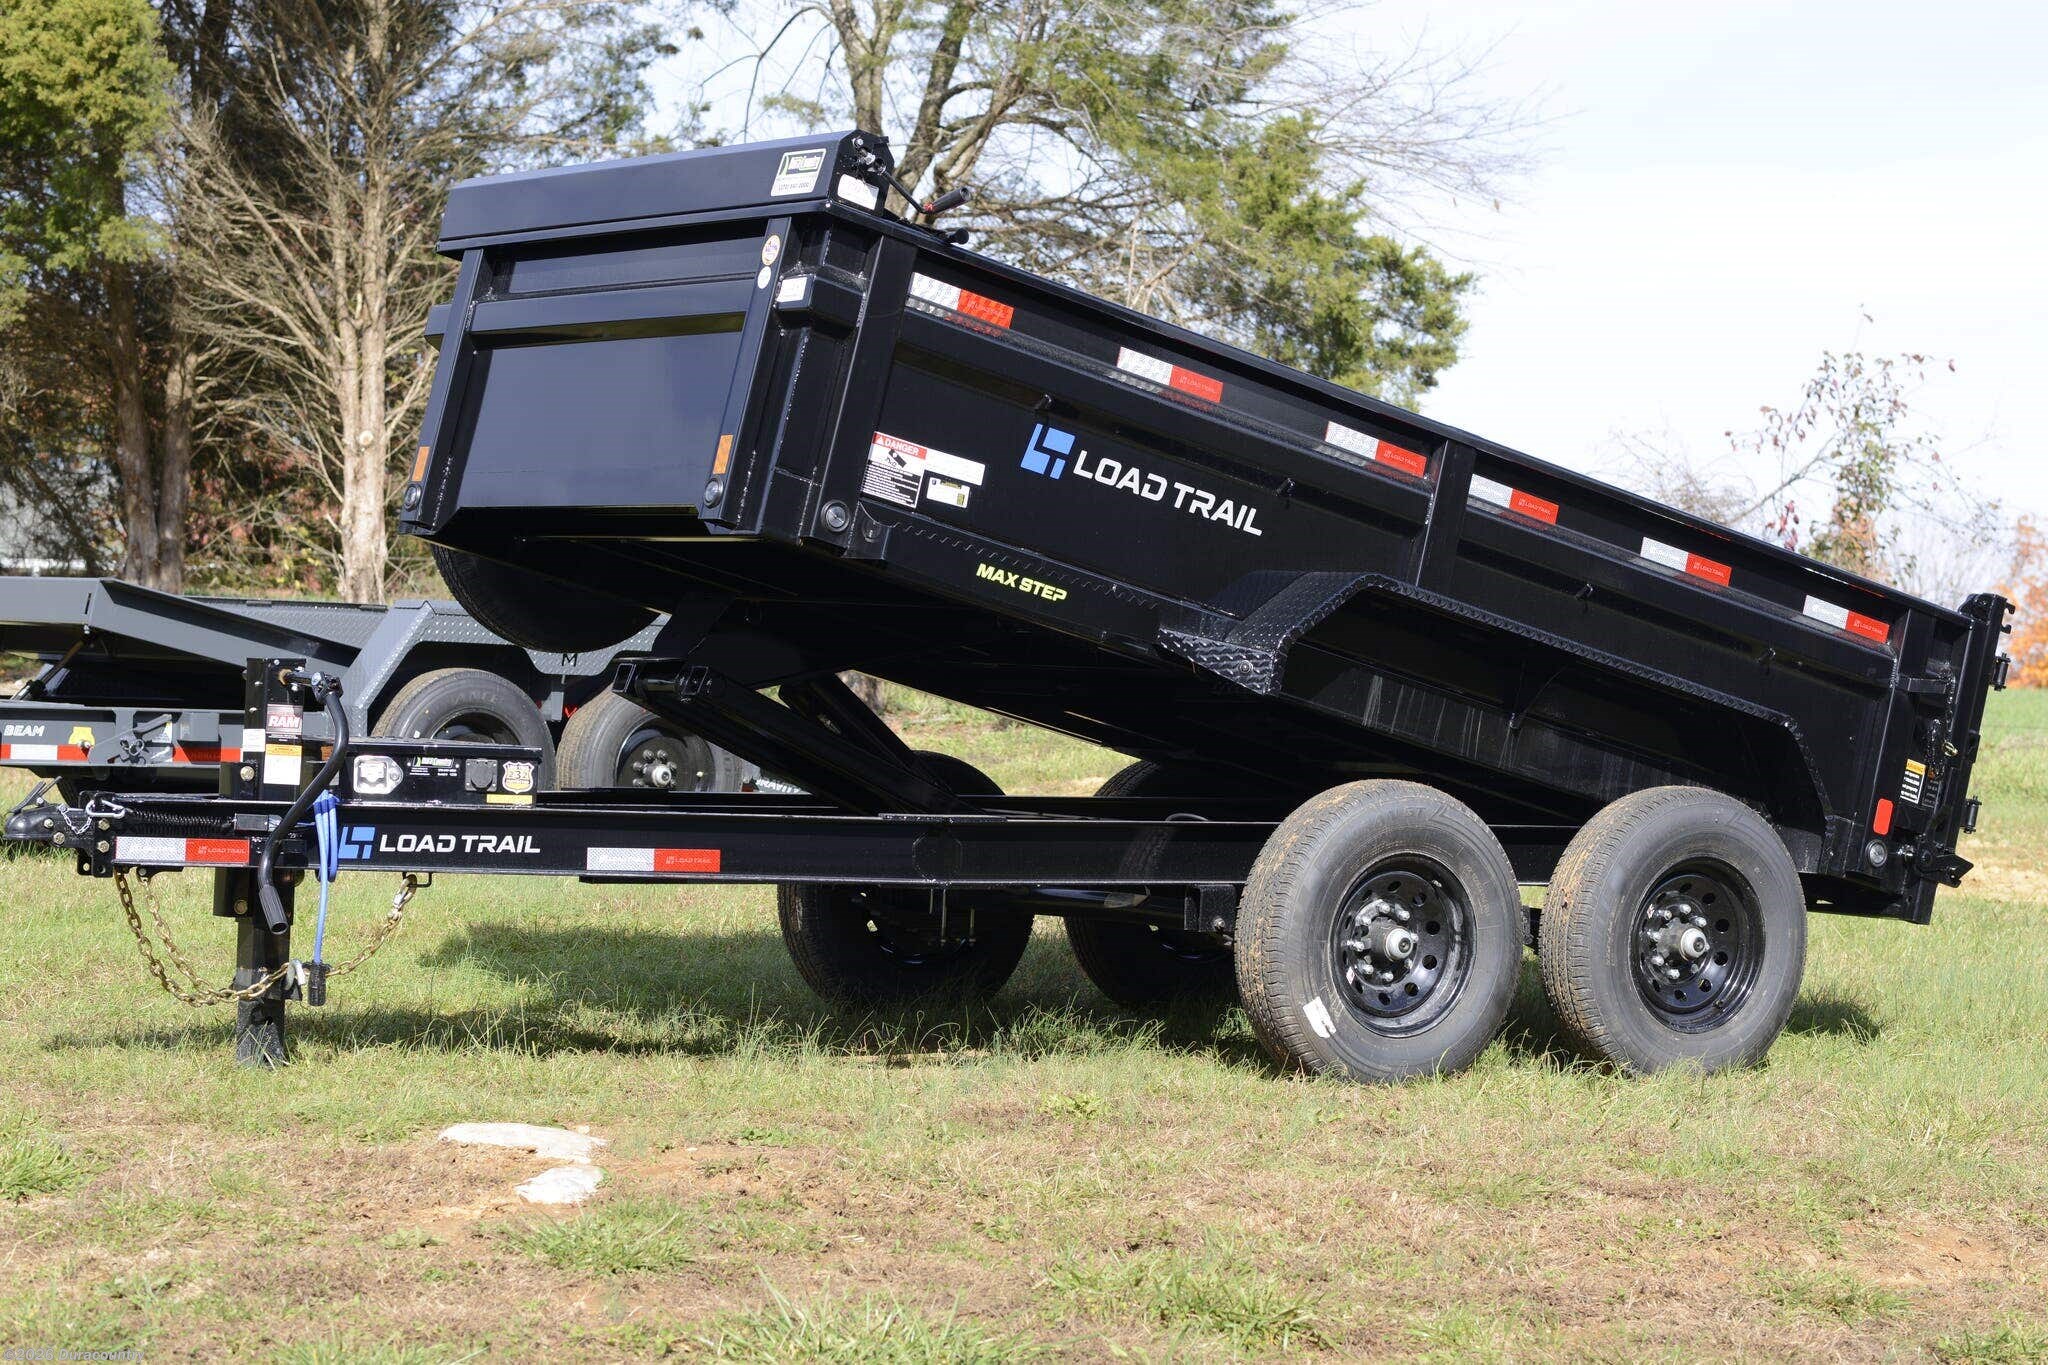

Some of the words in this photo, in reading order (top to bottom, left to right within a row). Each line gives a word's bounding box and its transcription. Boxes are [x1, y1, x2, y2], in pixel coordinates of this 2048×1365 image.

[884, 438, 919, 456] DANGER
[1073, 449, 1168, 502] LOAD
[1173, 481, 1262, 536] TRAIL
[976, 563, 1020, 588] MAX
[1018, 577, 1068, 602] STEP
[3, 724, 46, 737] BEAM
[268, 715, 301, 728] RAM
[379, 833, 456, 854] LOAD
[460, 834, 541, 855] TRAIL
